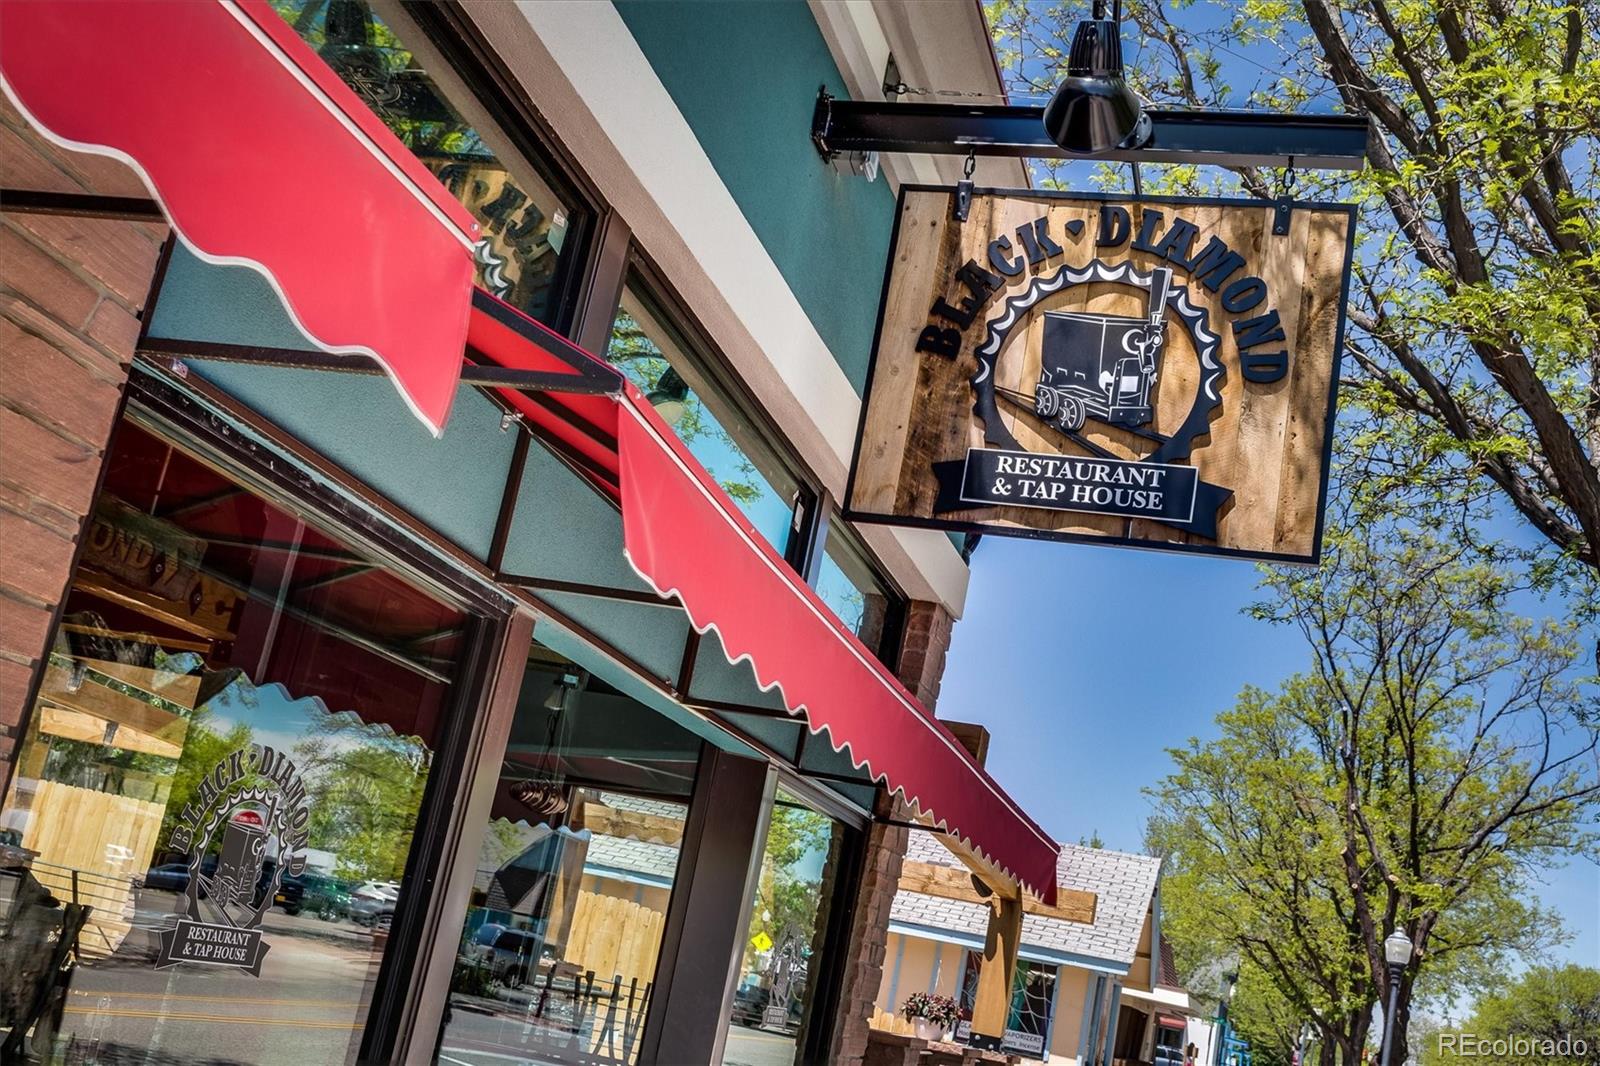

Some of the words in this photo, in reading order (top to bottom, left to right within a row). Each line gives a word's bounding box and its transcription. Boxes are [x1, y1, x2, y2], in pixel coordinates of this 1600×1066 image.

[915, 217, 1064, 361] BLACK
[1097, 205, 1289, 384] DIAMOND
[995, 455, 1166, 488] RESTAURANT
[991, 477, 1012, 496] &
[1018, 479, 1066, 501] TAP
[1070, 484, 1163, 510] HOUSE
[169, 749, 246, 855] BLACK
[258, 746, 310, 877] DIAMOND
[182, 942, 192, 955] &
[194, 943, 213, 957] TAP
[213, 945, 247, 961] HOUSE
[187, 926, 252, 946] RESTAURANT
